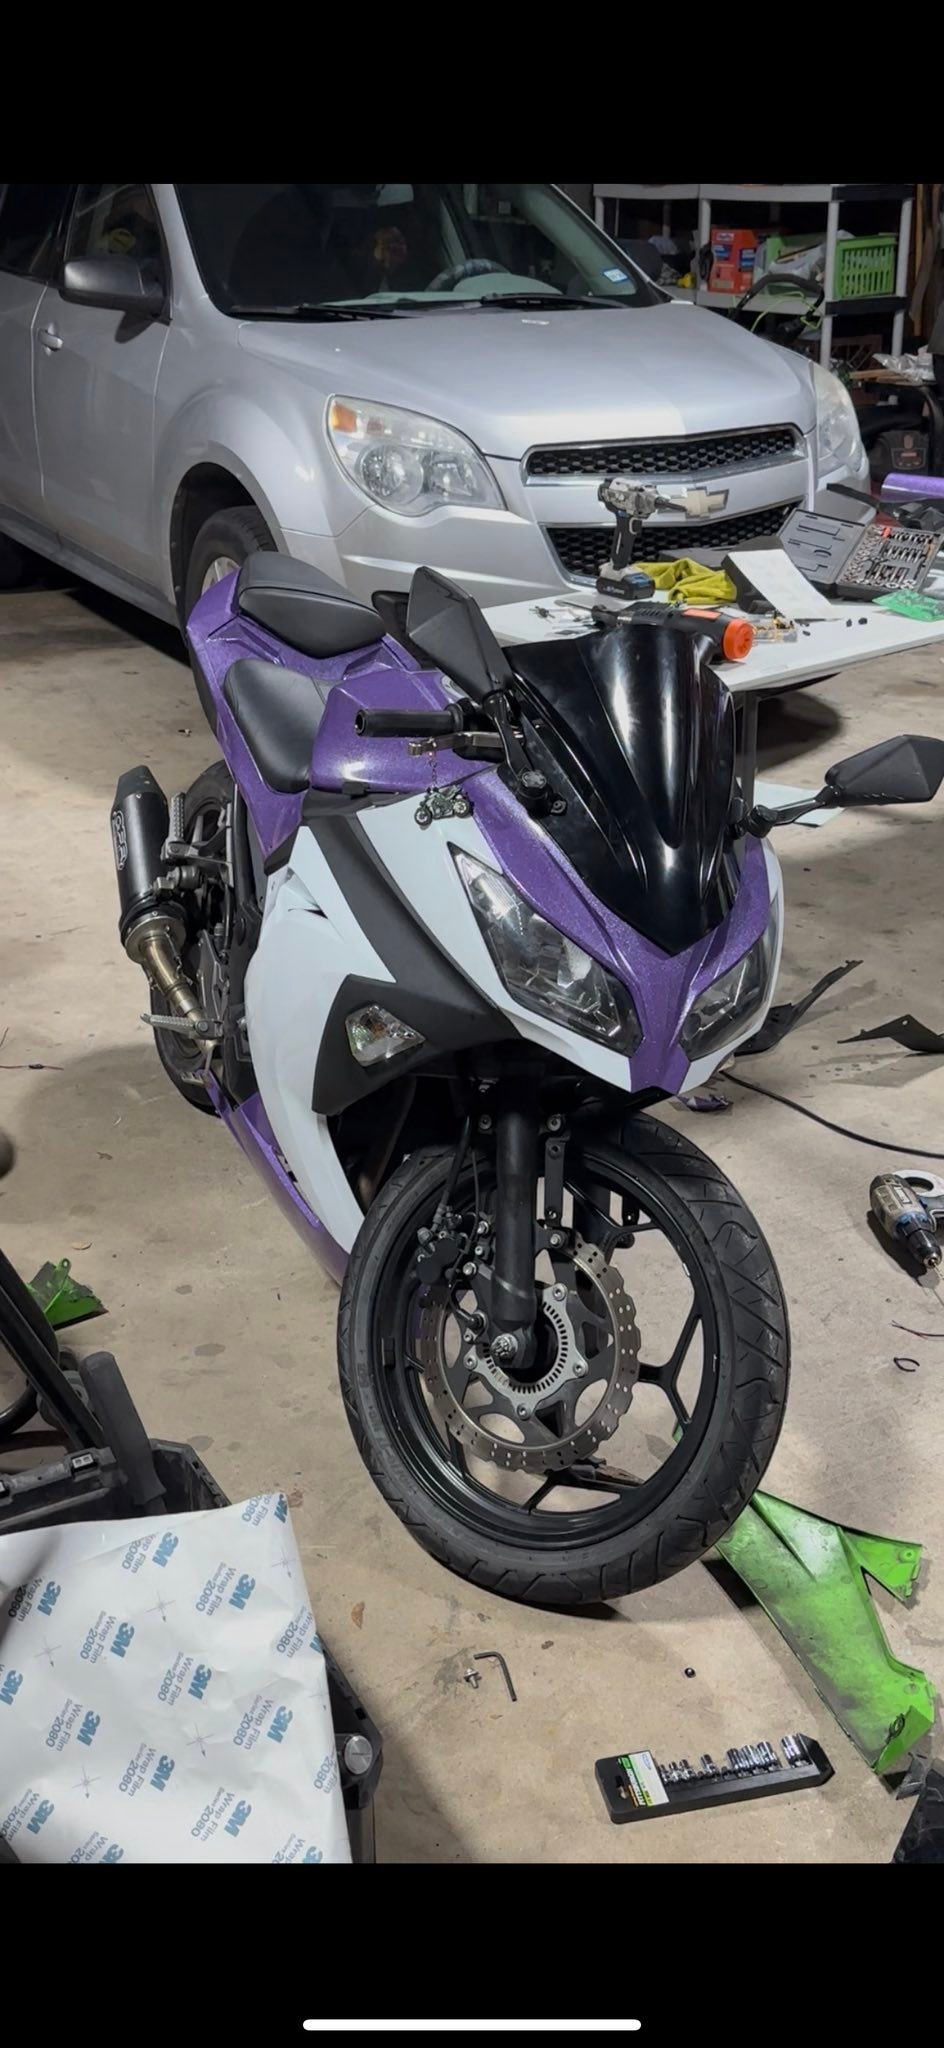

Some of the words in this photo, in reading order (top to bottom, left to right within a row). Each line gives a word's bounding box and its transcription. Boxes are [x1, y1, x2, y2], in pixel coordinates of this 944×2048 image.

[252, 1505, 269, 1526] Film
[121, 1539, 141, 1570] 2080
[131, 1552, 146, 1574] Film
[152, 1532, 179, 1567] 3M
[195, 1579, 216, 1612] 2080
[216, 1567, 237, 1594] Wrap
[228, 1574, 256, 1610] 3M
[8, 1585, 26, 1618] 2080
[17, 1600, 32, 1622] Film
[36, 1581, 61, 1616] 3M
[206, 1594, 223, 1616] Film
[79, 1628, 101, 1660] 2080
[98, 1616, 116, 1642] Wrap
[110, 1622, 135, 1658] 3M
[276, 1621, 299, 1653] 2080
[89, 1642, 104, 1664] Film
[286, 1636, 304, 1658] Film
[157, 1669, 178, 1701] 2080
[175, 1657, 194, 1684] Wrap
[188, 1664, 212, 1700] 3M
[0, 1670, 23, 1705] 3M
[167, 1684, 182, 1706] Film
[65, 1704, 83, 1730] Wrap
[76, 1710, 101, 1746] 3M
[254, 1699, 274, 1726] Wrap
[266, 1706, 293, 1743] 3M
[45, 1716, 64, 1747] 2080
[56, 1730, 71, 1752] Film
[233, 1712, 254, 1746] 2080
[244, 1727, 260, 1750] Film
[118, 1759, 139, 1792] 2080
[139, 1748, 157, 1774] Wrap
[150, 1755, 175, 1791] 3M
[313, 1755, 333, 1789] 2080
[128, 1774, 145, 1797] Film
[20, 1793, 40, 1819] Wrap
[26, 1799, 55, 1835] 3M
[215, 1792, 235, 1818] Wrap
[223, 1800, 252, 1837] 3M
[7, 1819, 22, 1841] Film
[190, 1804, 214, 1840] 2080
[201, 1819, 218, 1842] Film
[85, 1836, 109, 1861] Wrap
